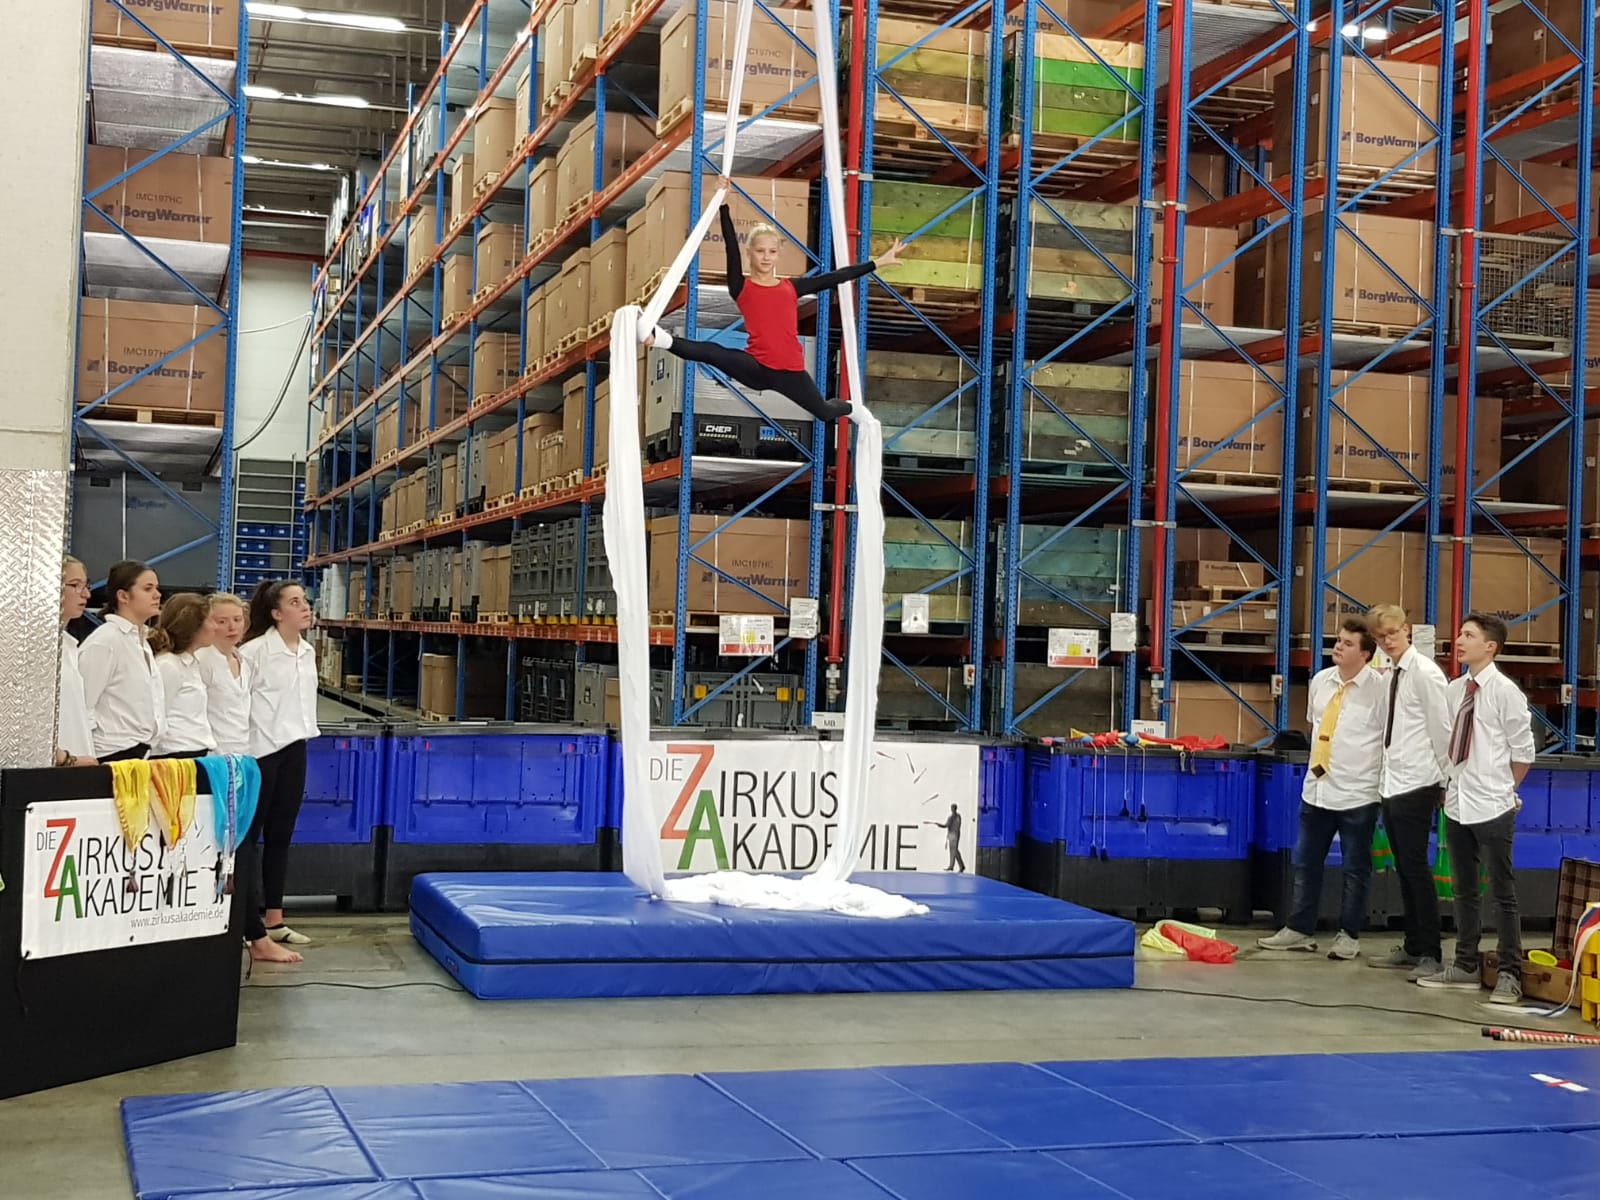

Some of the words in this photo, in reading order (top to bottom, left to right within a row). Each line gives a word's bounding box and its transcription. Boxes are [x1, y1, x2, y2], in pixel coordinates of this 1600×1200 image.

[724, 59, 809, 79] BrgWarner
[122, 204, 213, 225] BorgWarner
[1358, 288, 1429, 305] BorgWarn
[705, 425, 732, 434] CHEP
[648, 757, 683, 782] DIE
[660, 743, 839, 839] ZIRKUS
[36, 831, 57, 852] DIE
[44, 817, 154, 899] ZIRKUS
[130, 908, 225, 929] www.zirkusakademie.de
